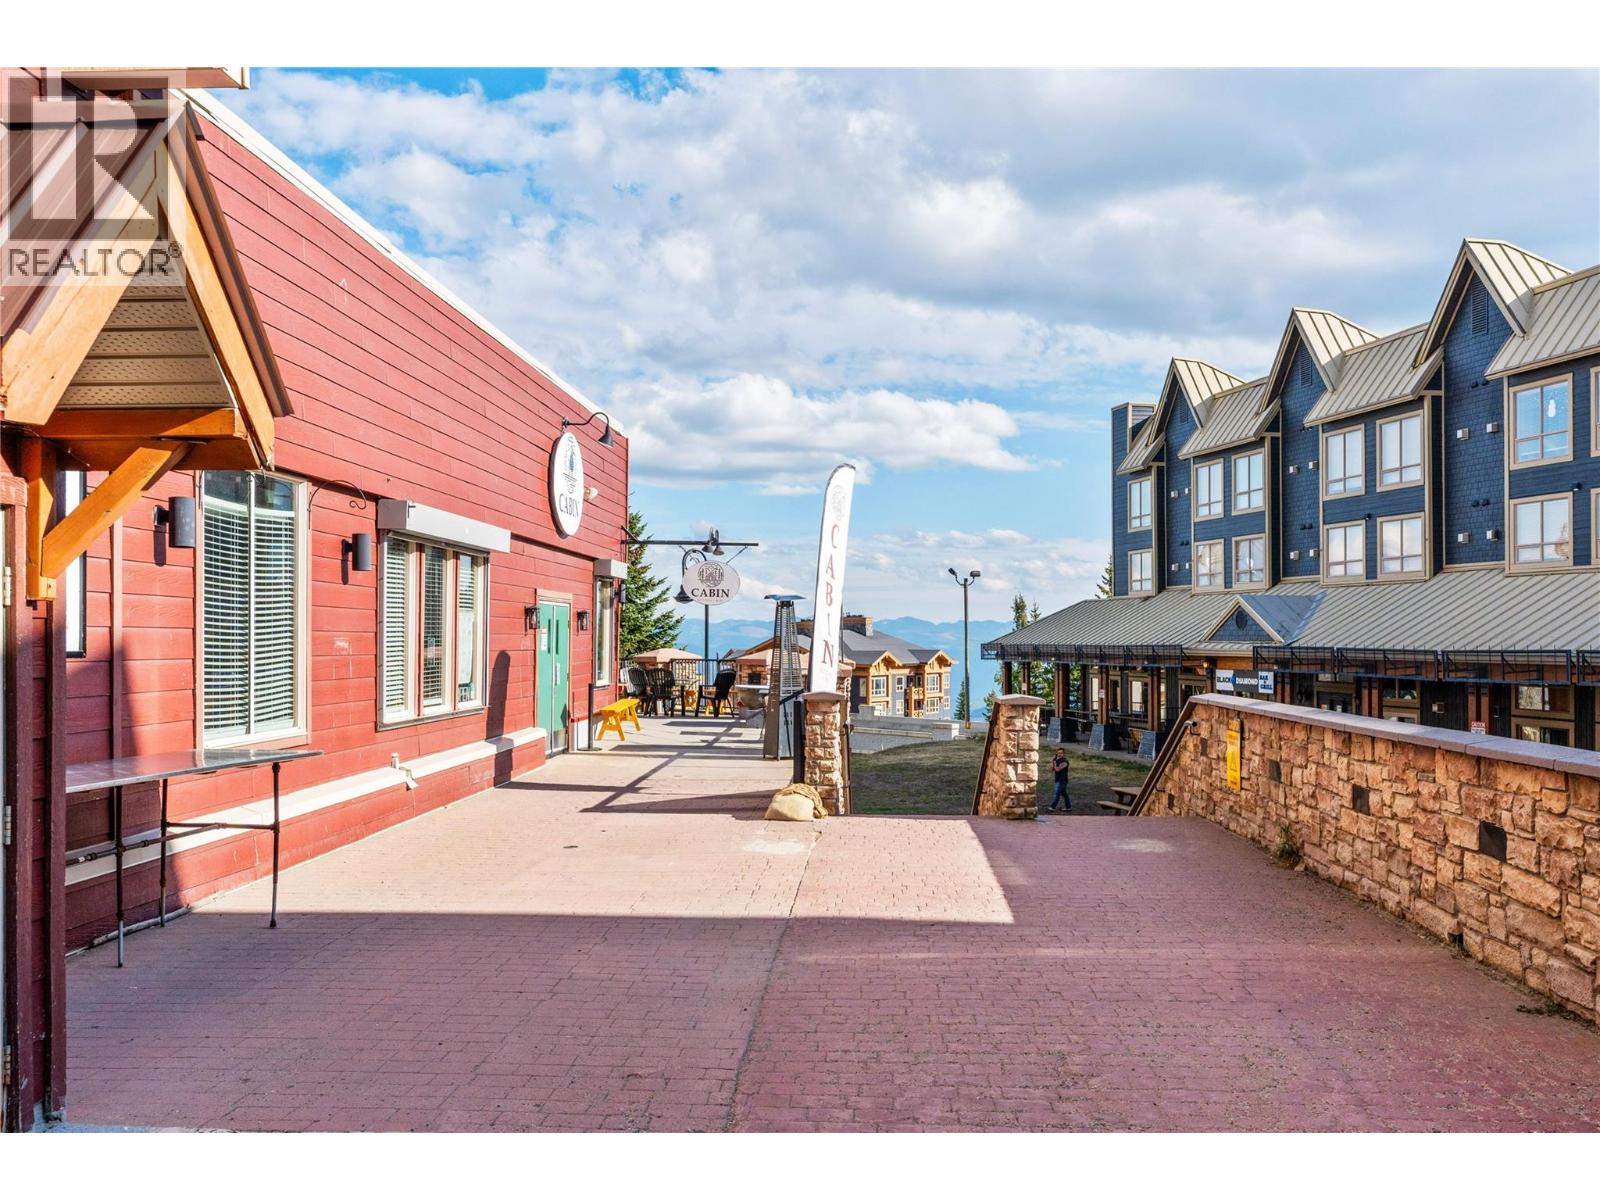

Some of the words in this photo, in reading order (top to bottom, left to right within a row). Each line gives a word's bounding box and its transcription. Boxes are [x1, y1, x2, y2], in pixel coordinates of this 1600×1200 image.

[559, 493, 579, 519] CABIN
[691, 588, 730, 598] CABIN
[822, 523, 840, 669] CABIN
